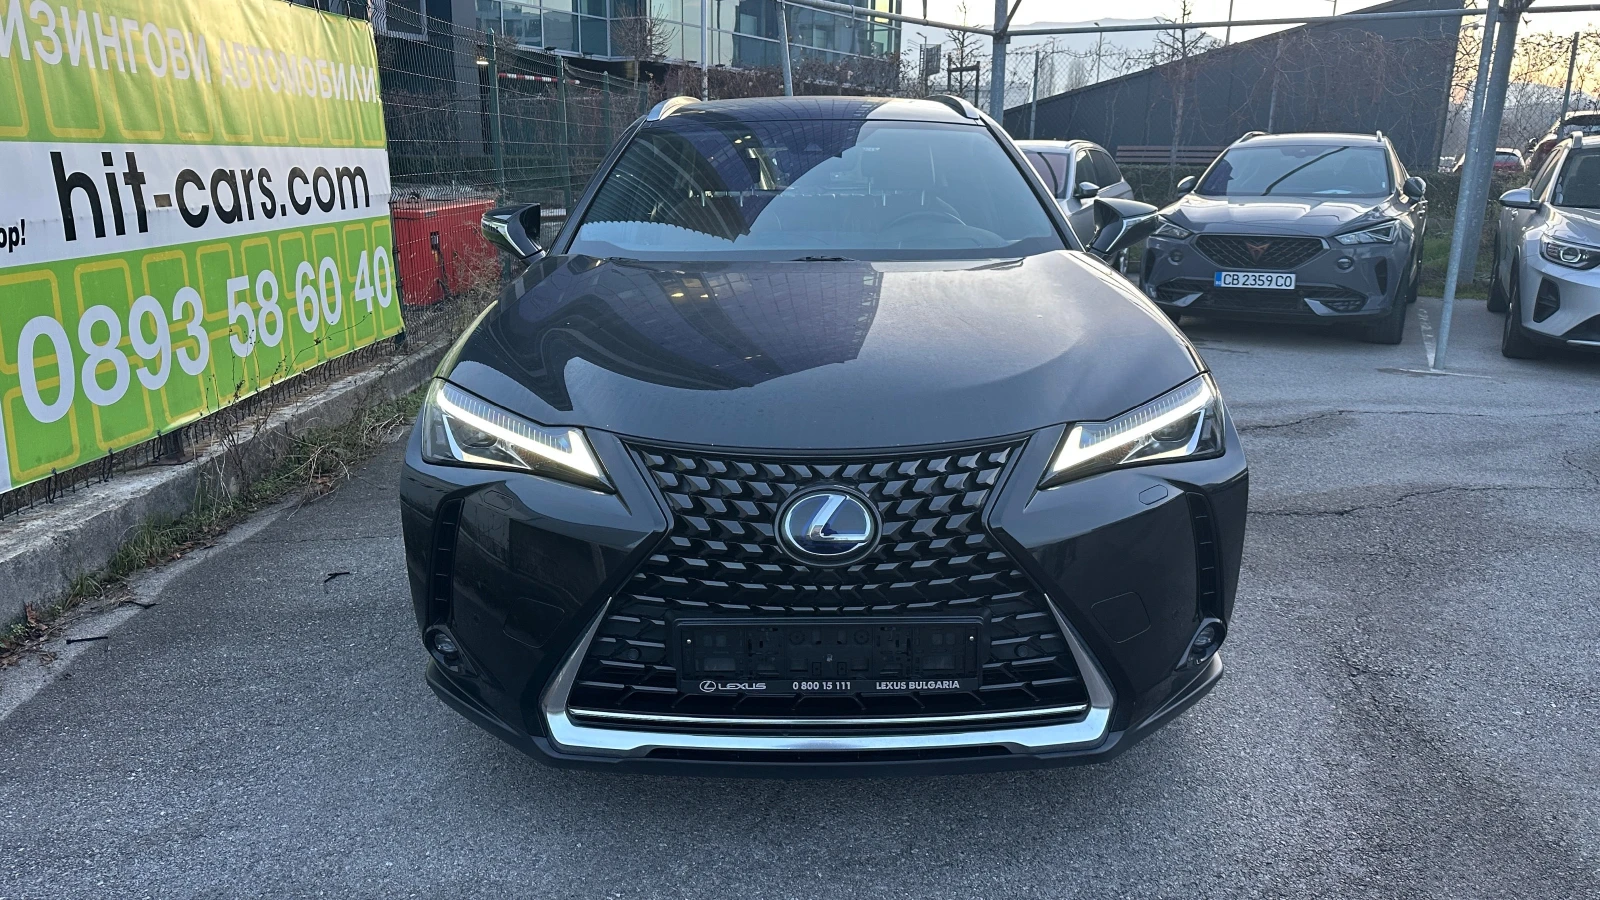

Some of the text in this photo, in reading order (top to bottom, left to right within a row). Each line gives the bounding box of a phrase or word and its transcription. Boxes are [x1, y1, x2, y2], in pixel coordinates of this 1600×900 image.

[219, 38, 377, 104] АВТОМОБИЛИ
[49, 150, 371, 242] hit-cars.com
[1223, 273, 1293, 288] CB 2359 CO
[17, 245, 393, 424] 0893 58 60 40
[718, 682, 767, 690] LEXUS
[792, 681, 851, 690] 0 800 15 111
[876, 680, 960, 690] LEXUS BULGARIA
